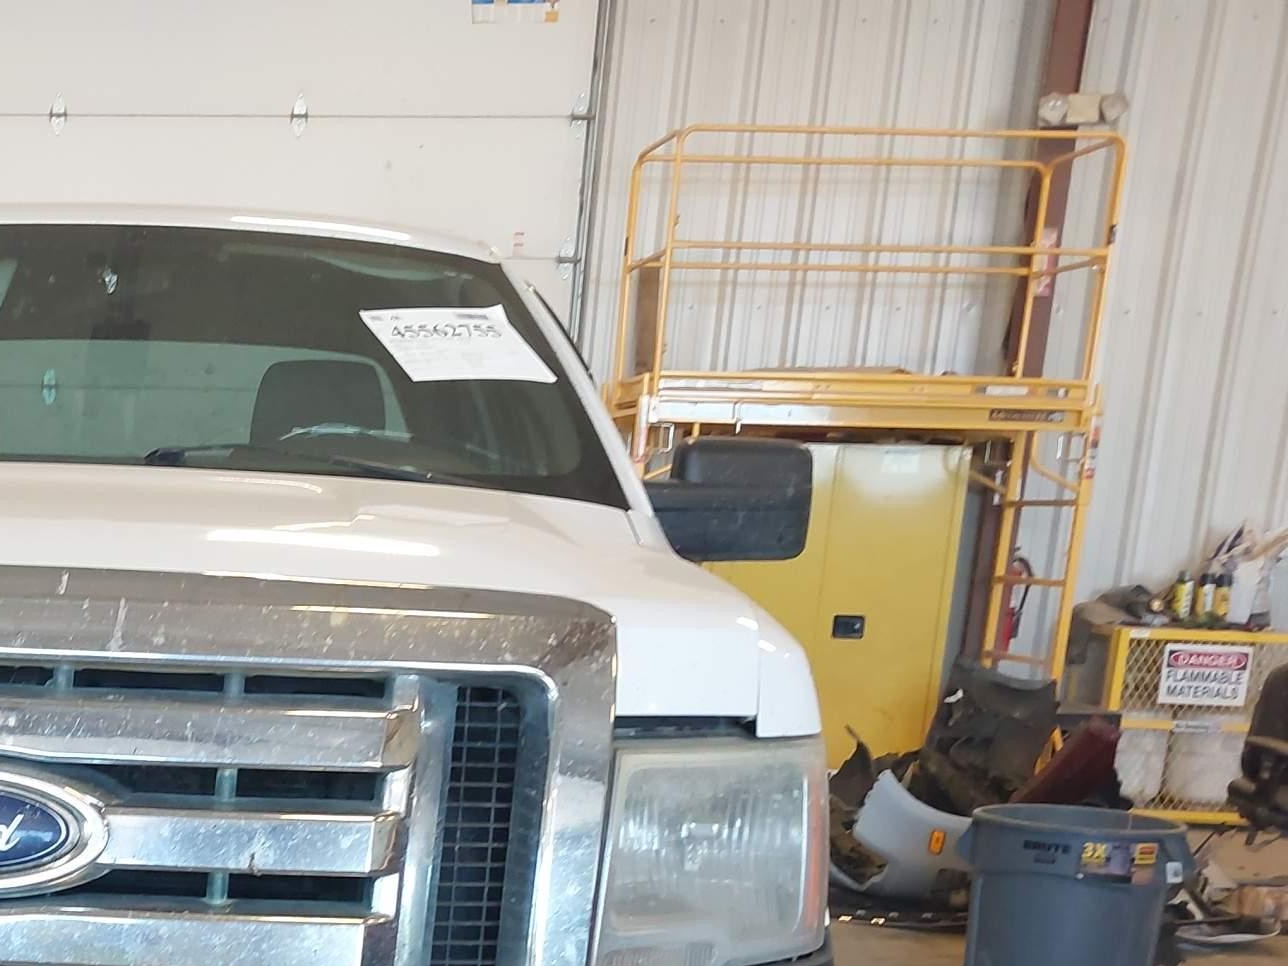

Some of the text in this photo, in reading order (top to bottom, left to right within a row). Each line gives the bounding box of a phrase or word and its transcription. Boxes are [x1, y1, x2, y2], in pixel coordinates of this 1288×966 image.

[391, 323, 502, 338] 45562755
[1177, 653, 1238, 668] DANGER
[1166, 670, 1245, 686] FLAMMABLE
[1166, 685, 1240, 700] MATERIALS
